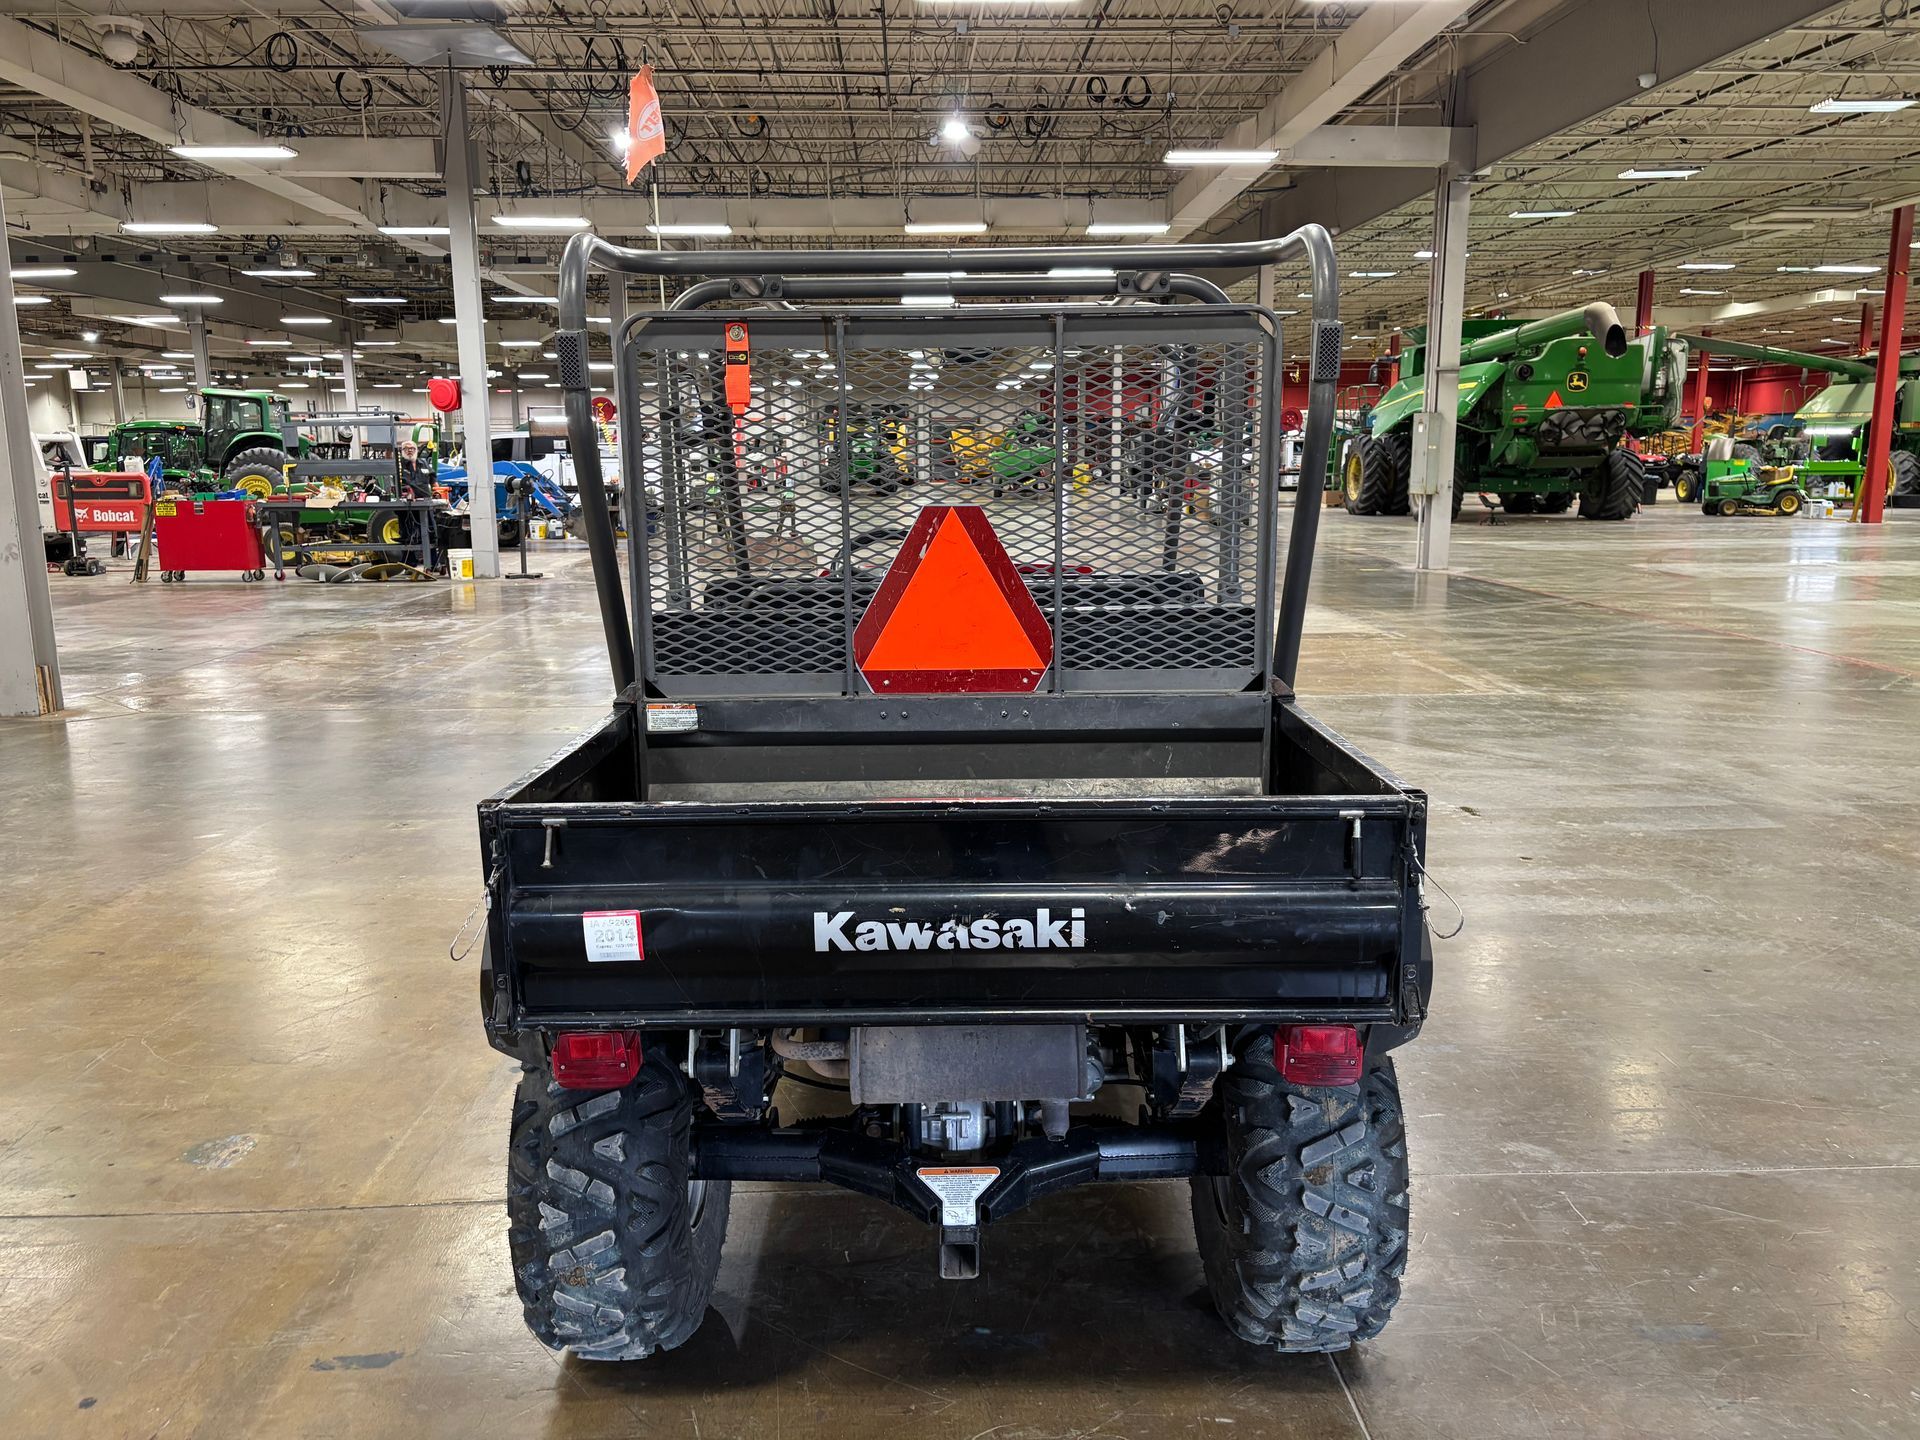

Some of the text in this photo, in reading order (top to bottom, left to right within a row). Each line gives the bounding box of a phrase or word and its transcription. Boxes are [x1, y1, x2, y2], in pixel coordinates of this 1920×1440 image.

[93, 509, 134, 522] Bobcat
[594, 928, 636, 943] 2014
[814, 908, 1085, 951] Kawasaki
